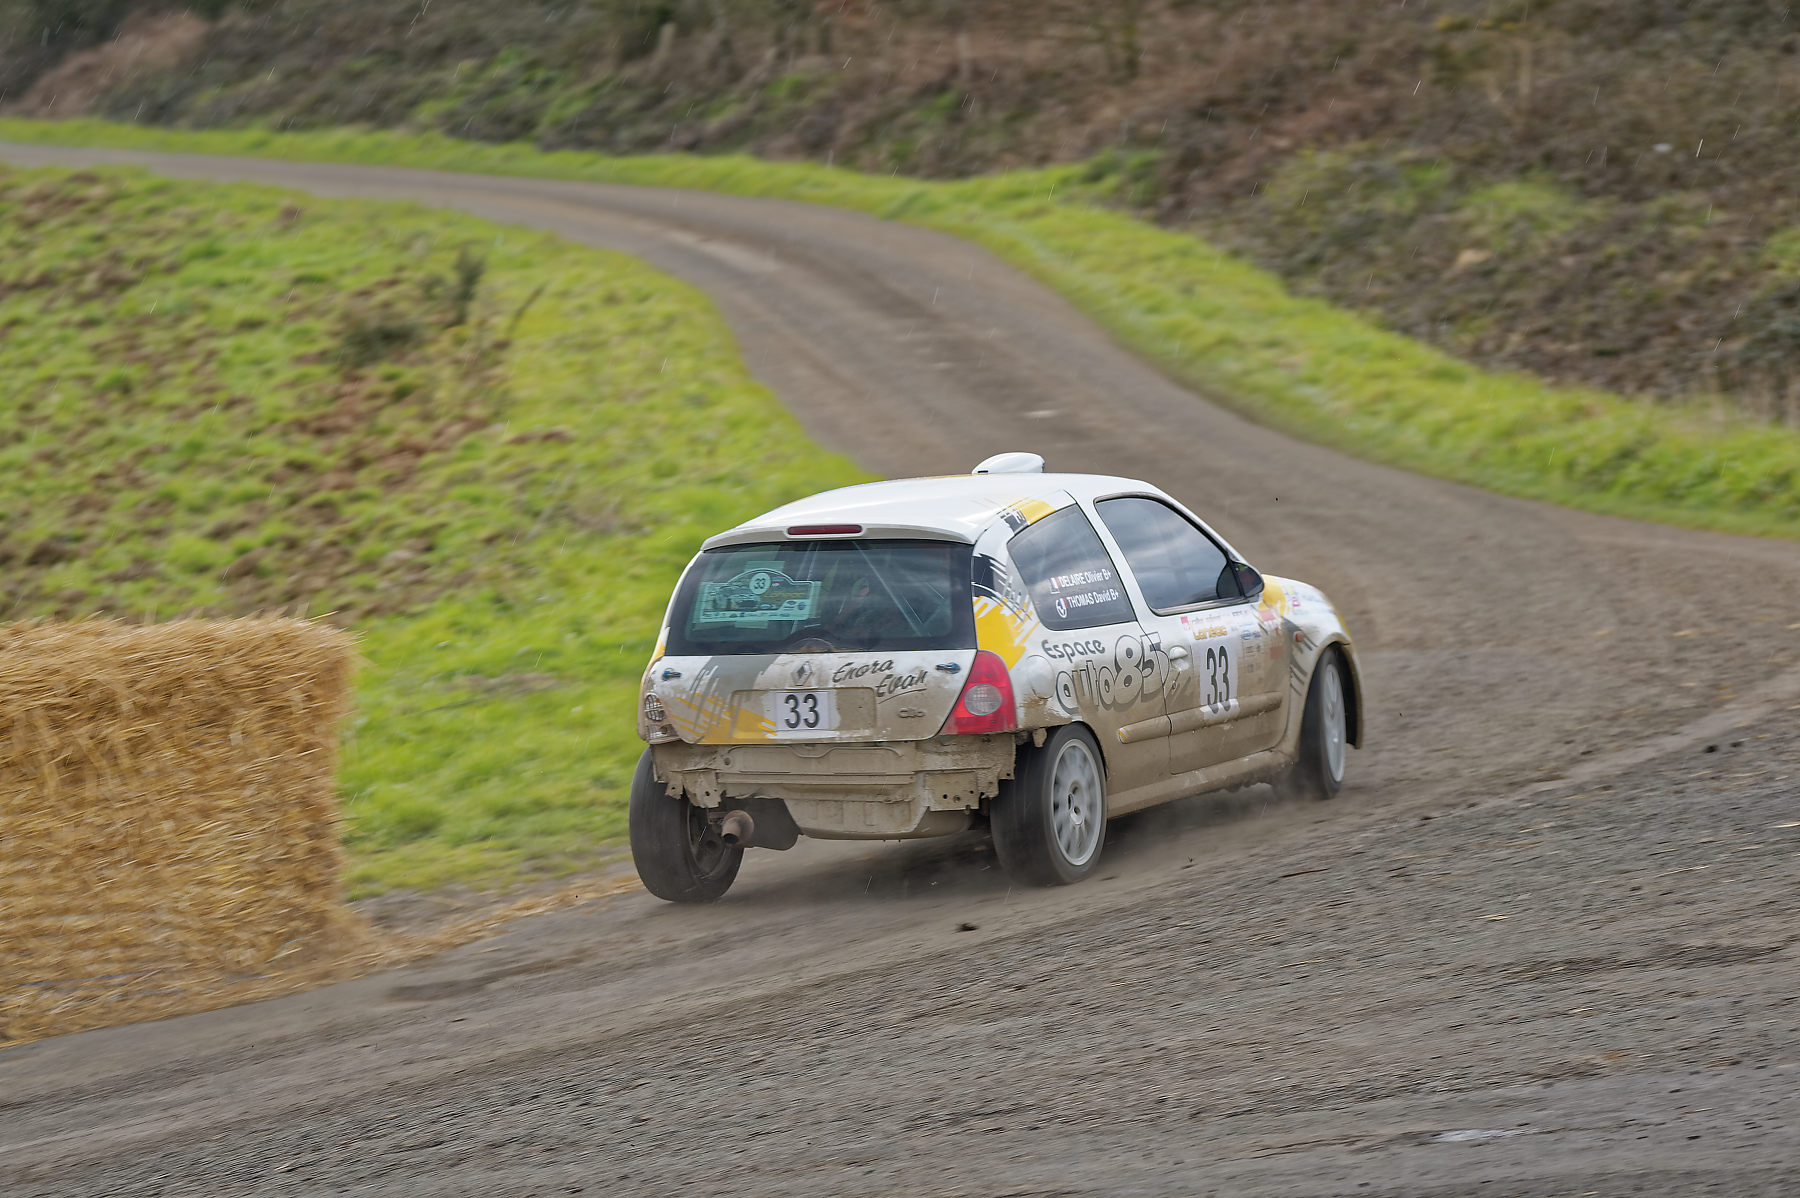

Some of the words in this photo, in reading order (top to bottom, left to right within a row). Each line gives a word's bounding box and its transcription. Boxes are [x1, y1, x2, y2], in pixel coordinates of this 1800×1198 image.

[753, 577, 767, 590] 33
[1057, 572, 1087, 588] DELAIRE
[1085, 570, 1104, 584] Olivier
[1101, 568, 1112, 580] B+
[1066, 592, 1095, 608] THOMAS
[1093, 590, 1111, 604] David
[1109, 588, 1119, 600] B+
[1041, 639, 1106, 663] Espace
[832, 658, 894, 684] Enora
[1206, 645, 1231, 714] 33
[875, 670, 928, 698] Evan
[784, 693, 820, 729] 33
